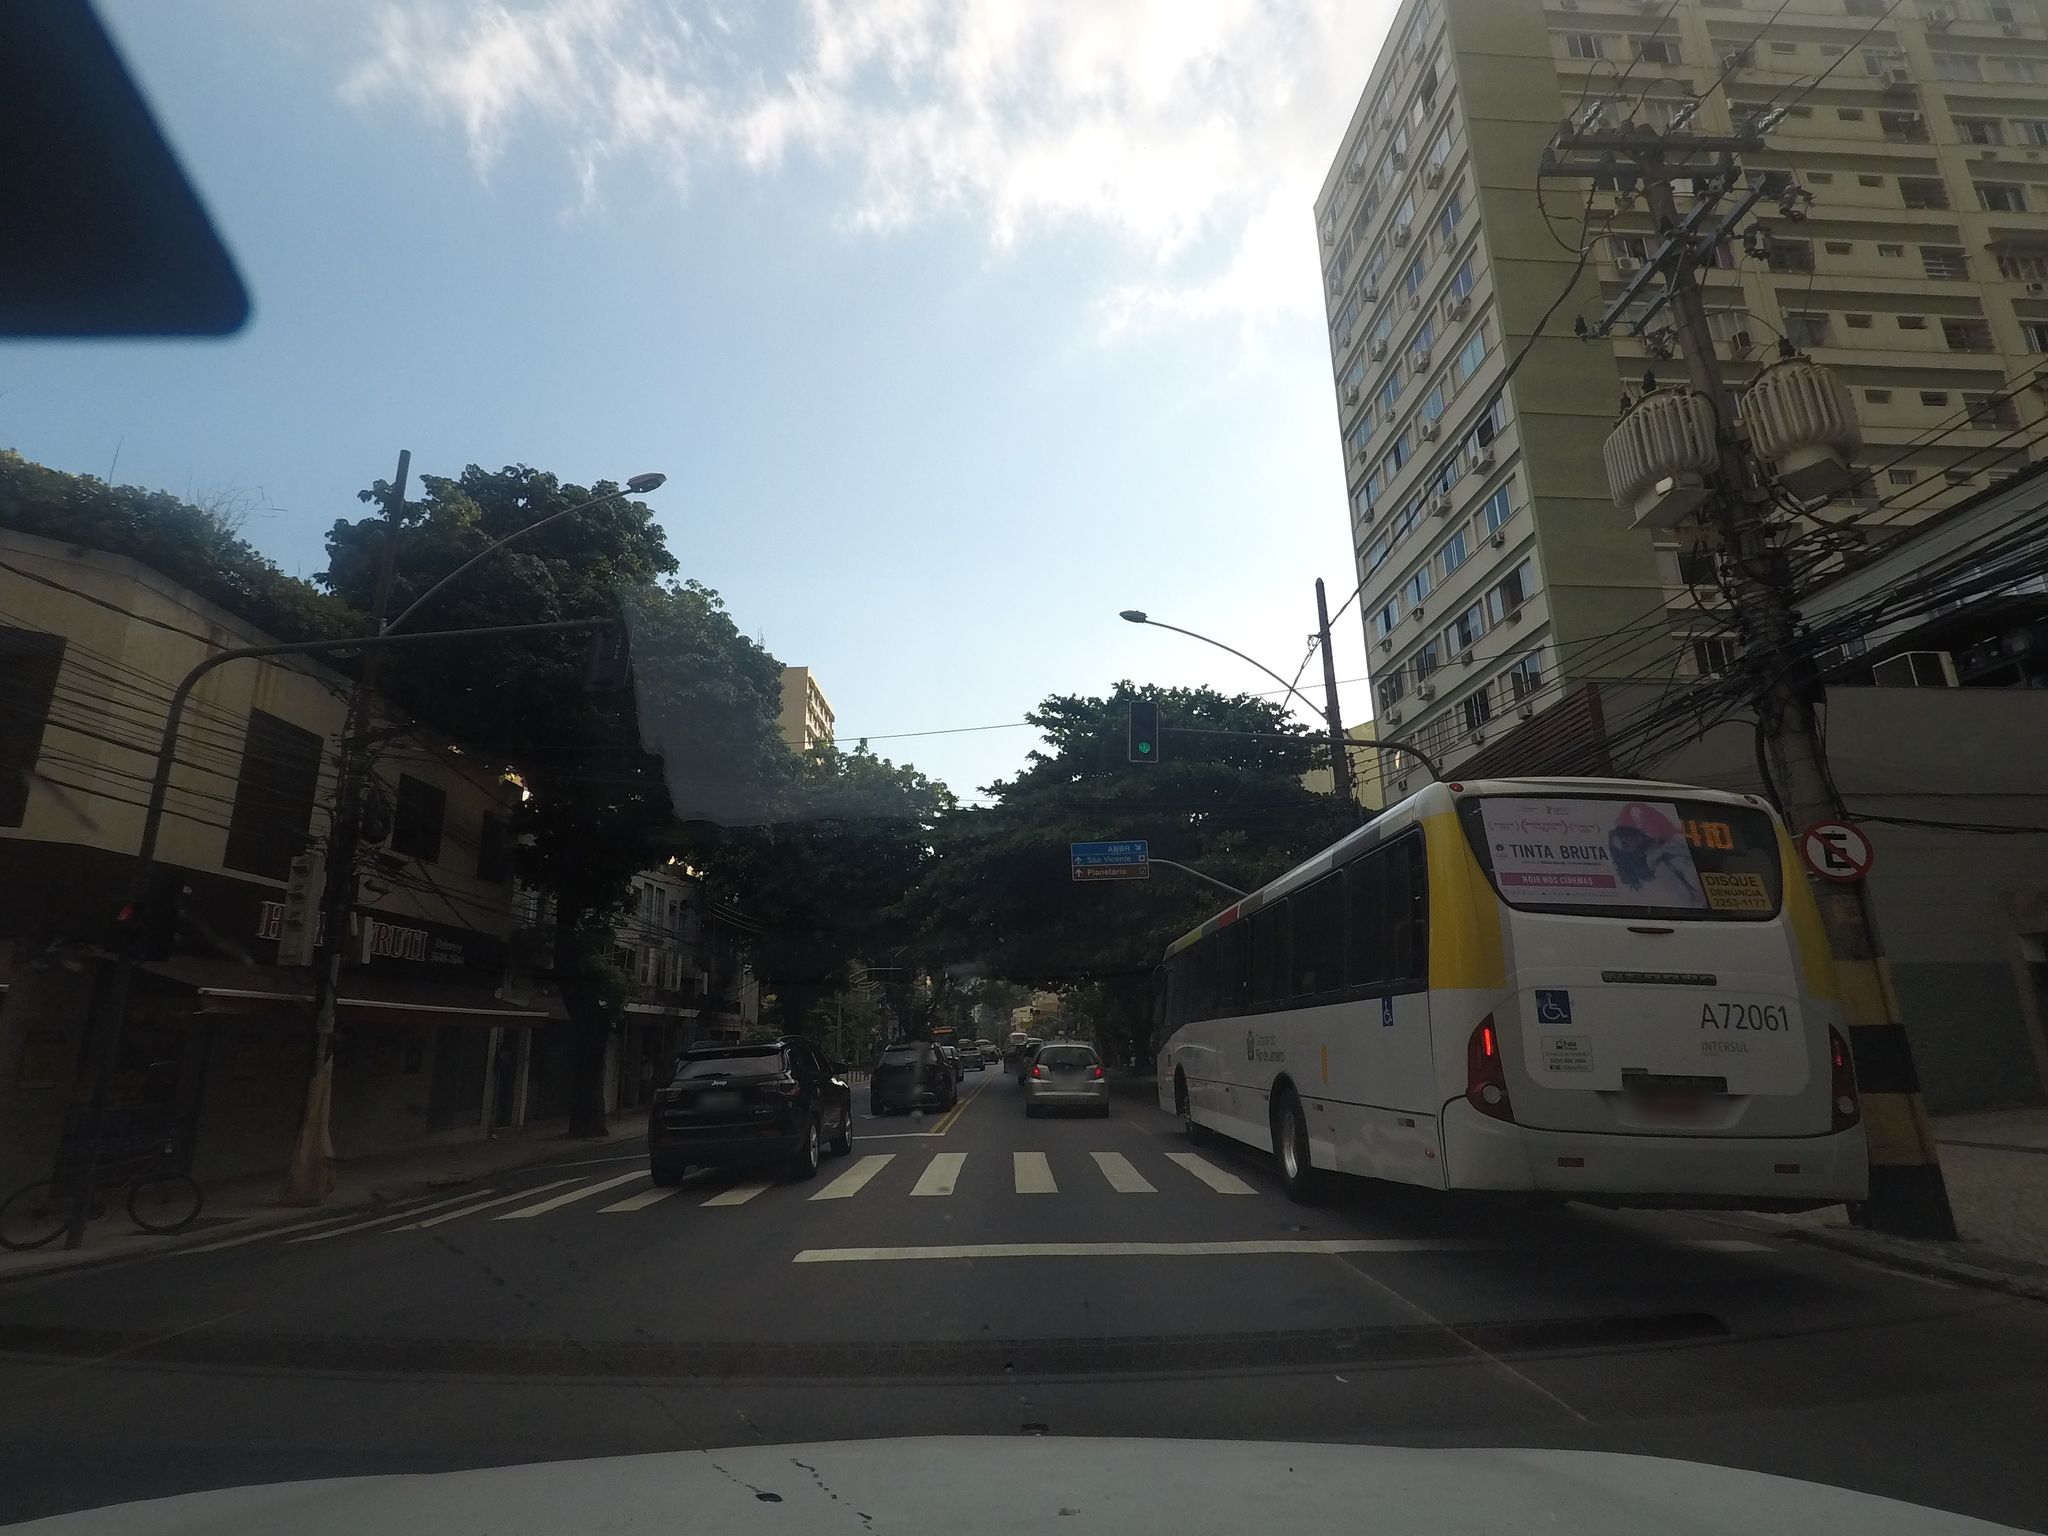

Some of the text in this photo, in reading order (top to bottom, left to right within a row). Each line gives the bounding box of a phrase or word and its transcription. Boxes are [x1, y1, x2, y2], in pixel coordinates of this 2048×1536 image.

[1509, 844, 1609, 860] TINTA BRUTA
[1821, 833, 1851, 868] E
[1103, 855, 1132, 863] Vicente
[1087, 867, 1127, 876] Planetário
[1559, 877, 1594, 885] CINEMAS
[1705, 875, 1760, 887] DISQUE
[1701, 1002, 1789, 1032] A72061
[1701, 1040, 1750, 1053] INTERSUL
